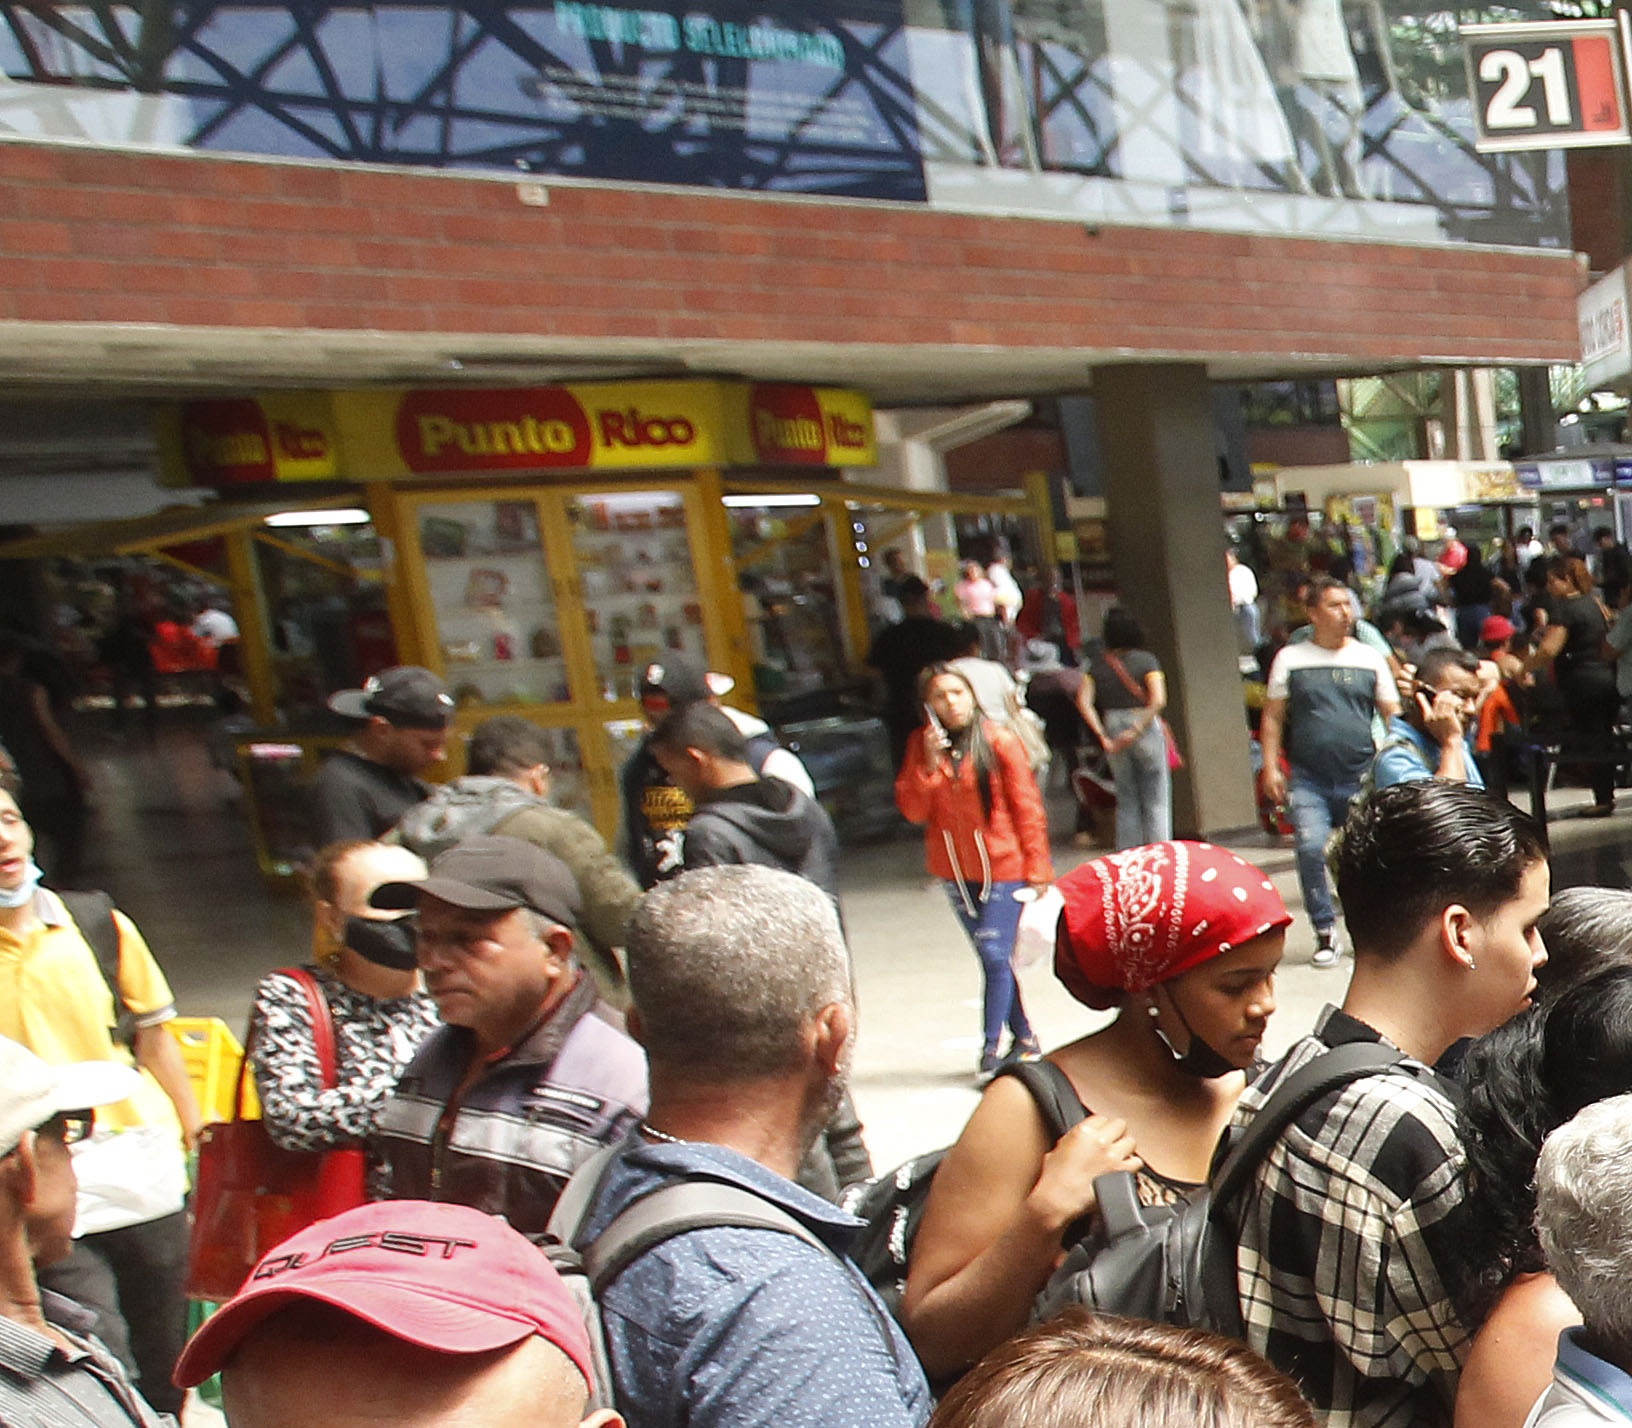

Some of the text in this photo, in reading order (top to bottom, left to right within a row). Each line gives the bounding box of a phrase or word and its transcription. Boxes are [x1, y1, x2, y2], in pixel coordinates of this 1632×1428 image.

[1478, 47, 1572, 128] 21
[417, 415, 574, 457] Punto
[757, 408, 822, 450] Punto
[253, 1231, 477, 1280] QUEST
